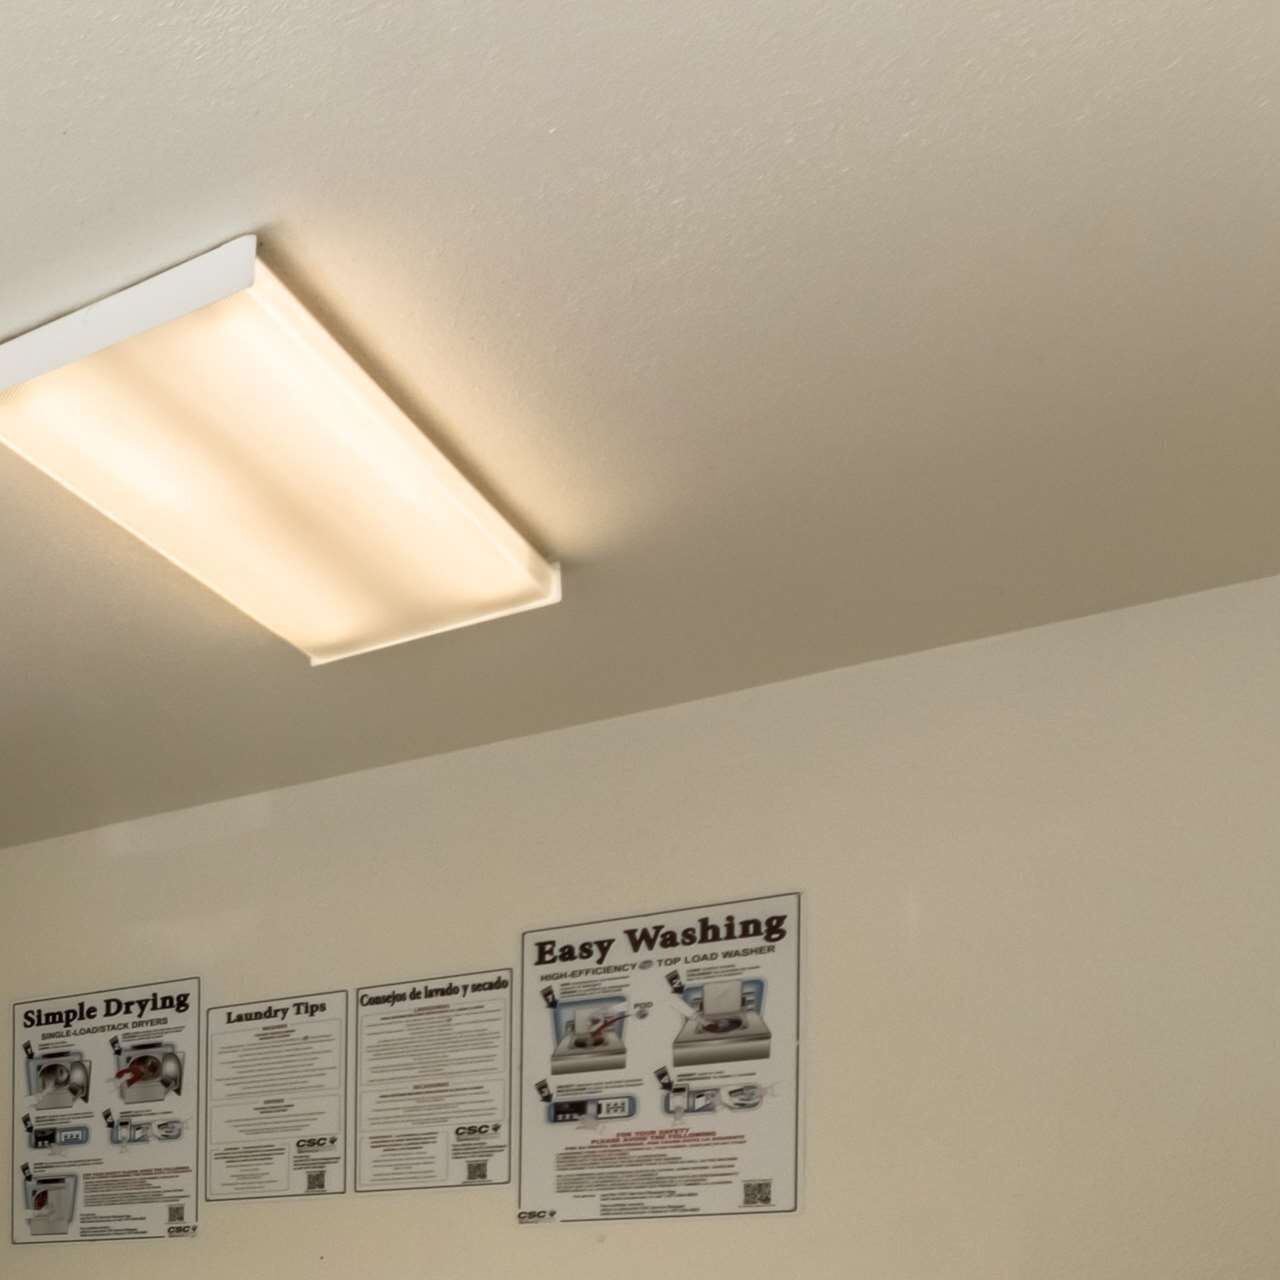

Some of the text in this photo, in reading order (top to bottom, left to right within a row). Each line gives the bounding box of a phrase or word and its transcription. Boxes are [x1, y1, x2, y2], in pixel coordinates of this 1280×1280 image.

[534, 914, 788, 966] Easy Washing
[540, 962, 638, 982] HIGH-EFFICIENCY
[656, 957, 681, 968] TOP
[684, 952, 718, 965] LOAD
[721, 944, 776, 960] WASHER
[359, 976, 509, 1008] Consejos de lavado y secado
[23, 992, 190, 1028] Simple Drying
[226, 1001, 327, 1025] Laundry Tips
[131, 1017, 168, 1028] DRYERS
[455, 1124, 490, 1136] CSC
[296, 1137, 327, 1148] CSC
[518, 1210, 546, 1219] CSC
[167, 1225, 190, 1233] CSC
